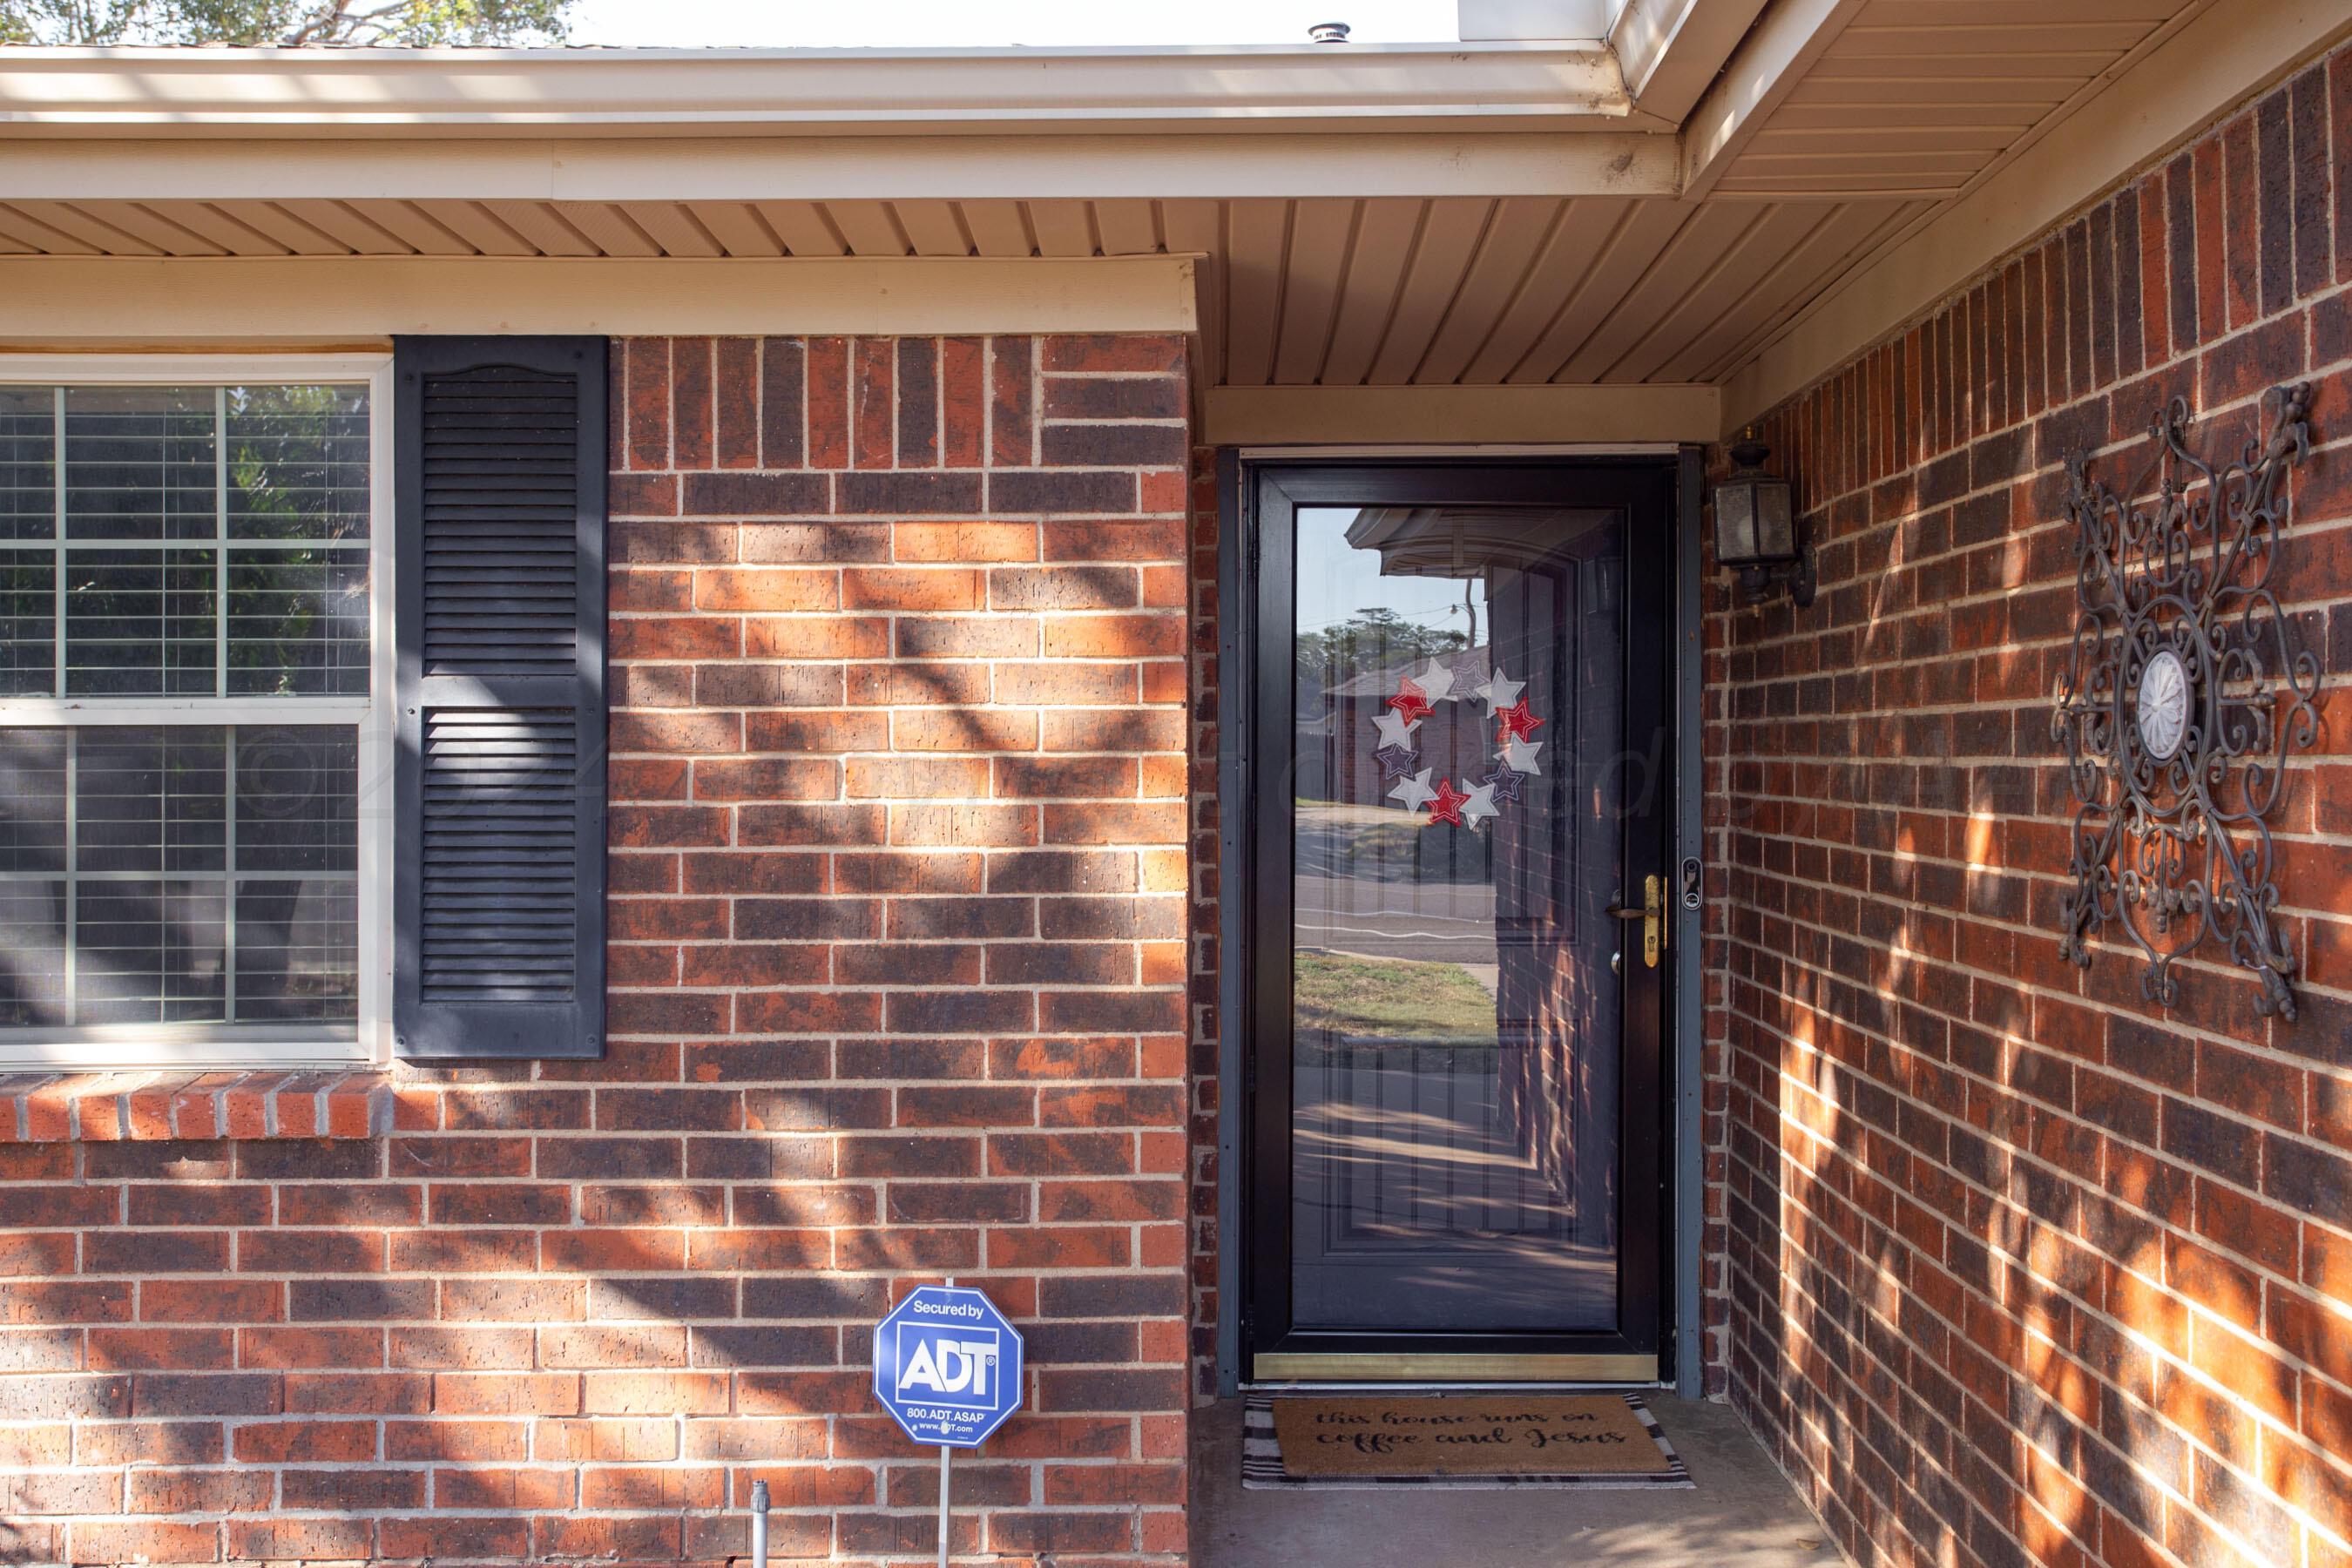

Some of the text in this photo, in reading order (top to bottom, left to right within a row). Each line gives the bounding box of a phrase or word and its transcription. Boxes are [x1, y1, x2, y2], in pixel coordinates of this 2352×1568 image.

[914, 1300, 984, 1320] Secured by
[907, 1407, 985, 1423] 800.ADT.ASAP
[1315, 1411, 1370, 1424] this
[1381, 1411, 1470, 1425] house
[1562, 1413, 1597, 1422] on
[1315, 1427, 1625, 1454] coffee and Jesus
